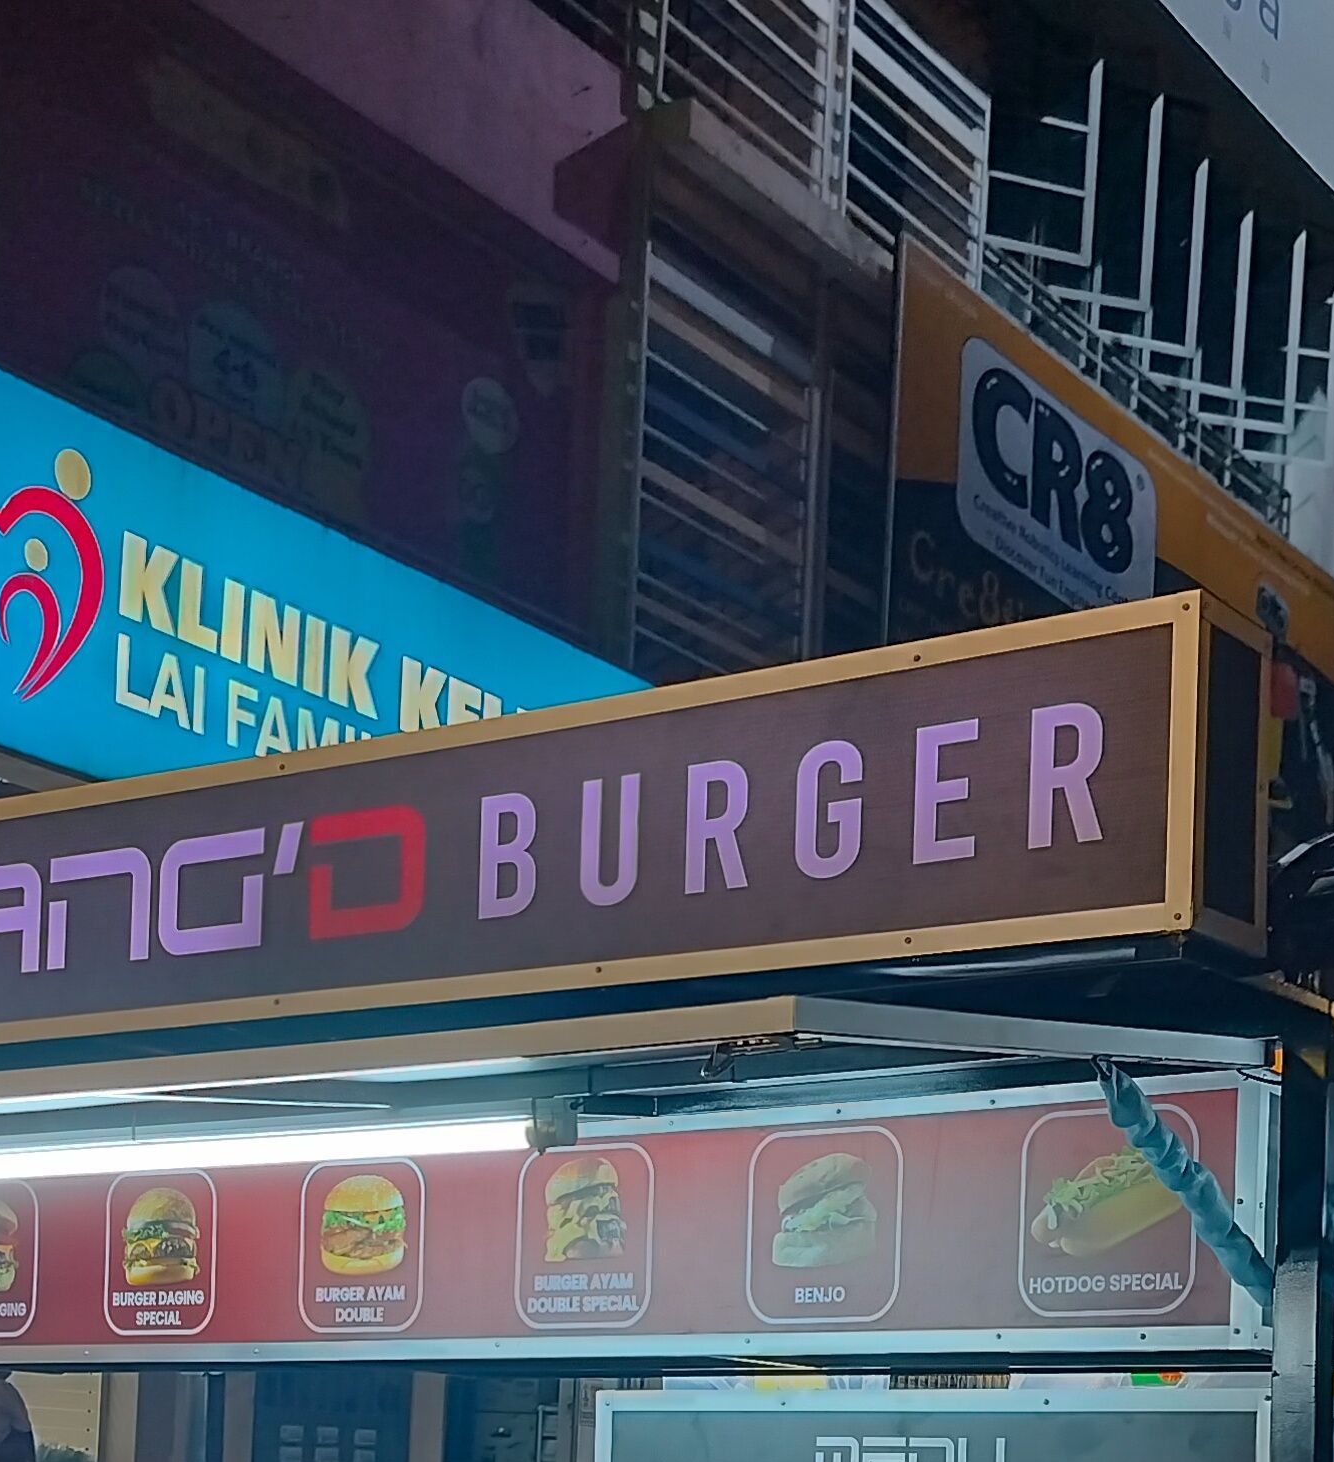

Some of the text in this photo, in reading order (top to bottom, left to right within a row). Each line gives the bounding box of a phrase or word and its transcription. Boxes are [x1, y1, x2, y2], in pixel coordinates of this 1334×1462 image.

[972, 368, 1134, 574] CR8
[119, 531, 379, 720] KLINIK
[116, 634, 205, 735] LAI
[478, 702, 1104, 920] BURGER
[1029, 1274, 1182, 1293] HOTDOG SPECIAL
[113, 1291, 204, 1305] BURGER DAGING
[316, 1286, 404, 1301] BURGER AYAM
[795, 1287, 845, 1302] BENJO
[136, 1311, 181, 1325] SPECIAL
[335, 1307, 383, 1323] DOUBLE
